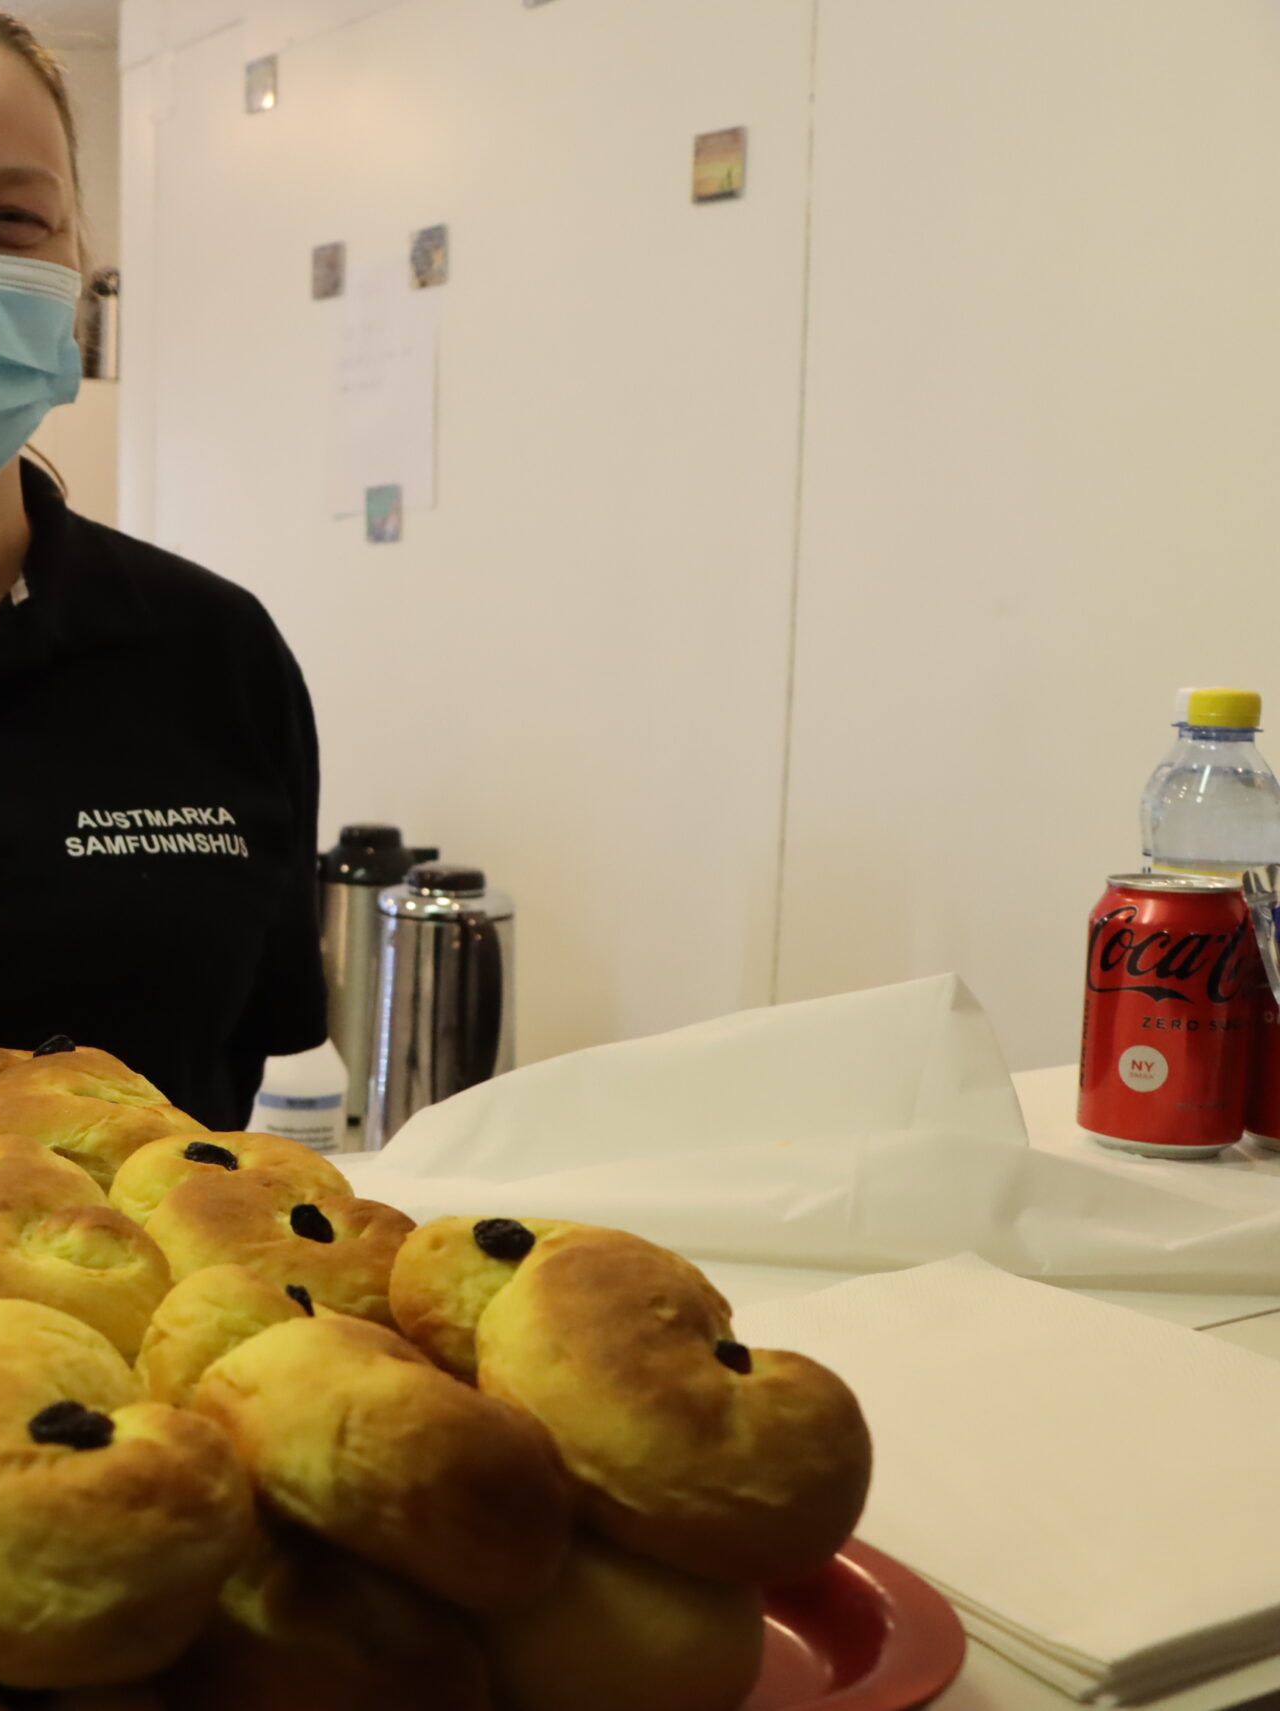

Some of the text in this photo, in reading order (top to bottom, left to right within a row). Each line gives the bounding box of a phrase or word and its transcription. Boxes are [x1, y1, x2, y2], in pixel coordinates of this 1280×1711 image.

[77, 806, 237, 829] AUSTMARKA
[65, 832, 249, 858] SAMFUNNSHUS
[1141, 1015, 1201, 1032] ZERO
[1131, 1059, 1156, 1072] NY
